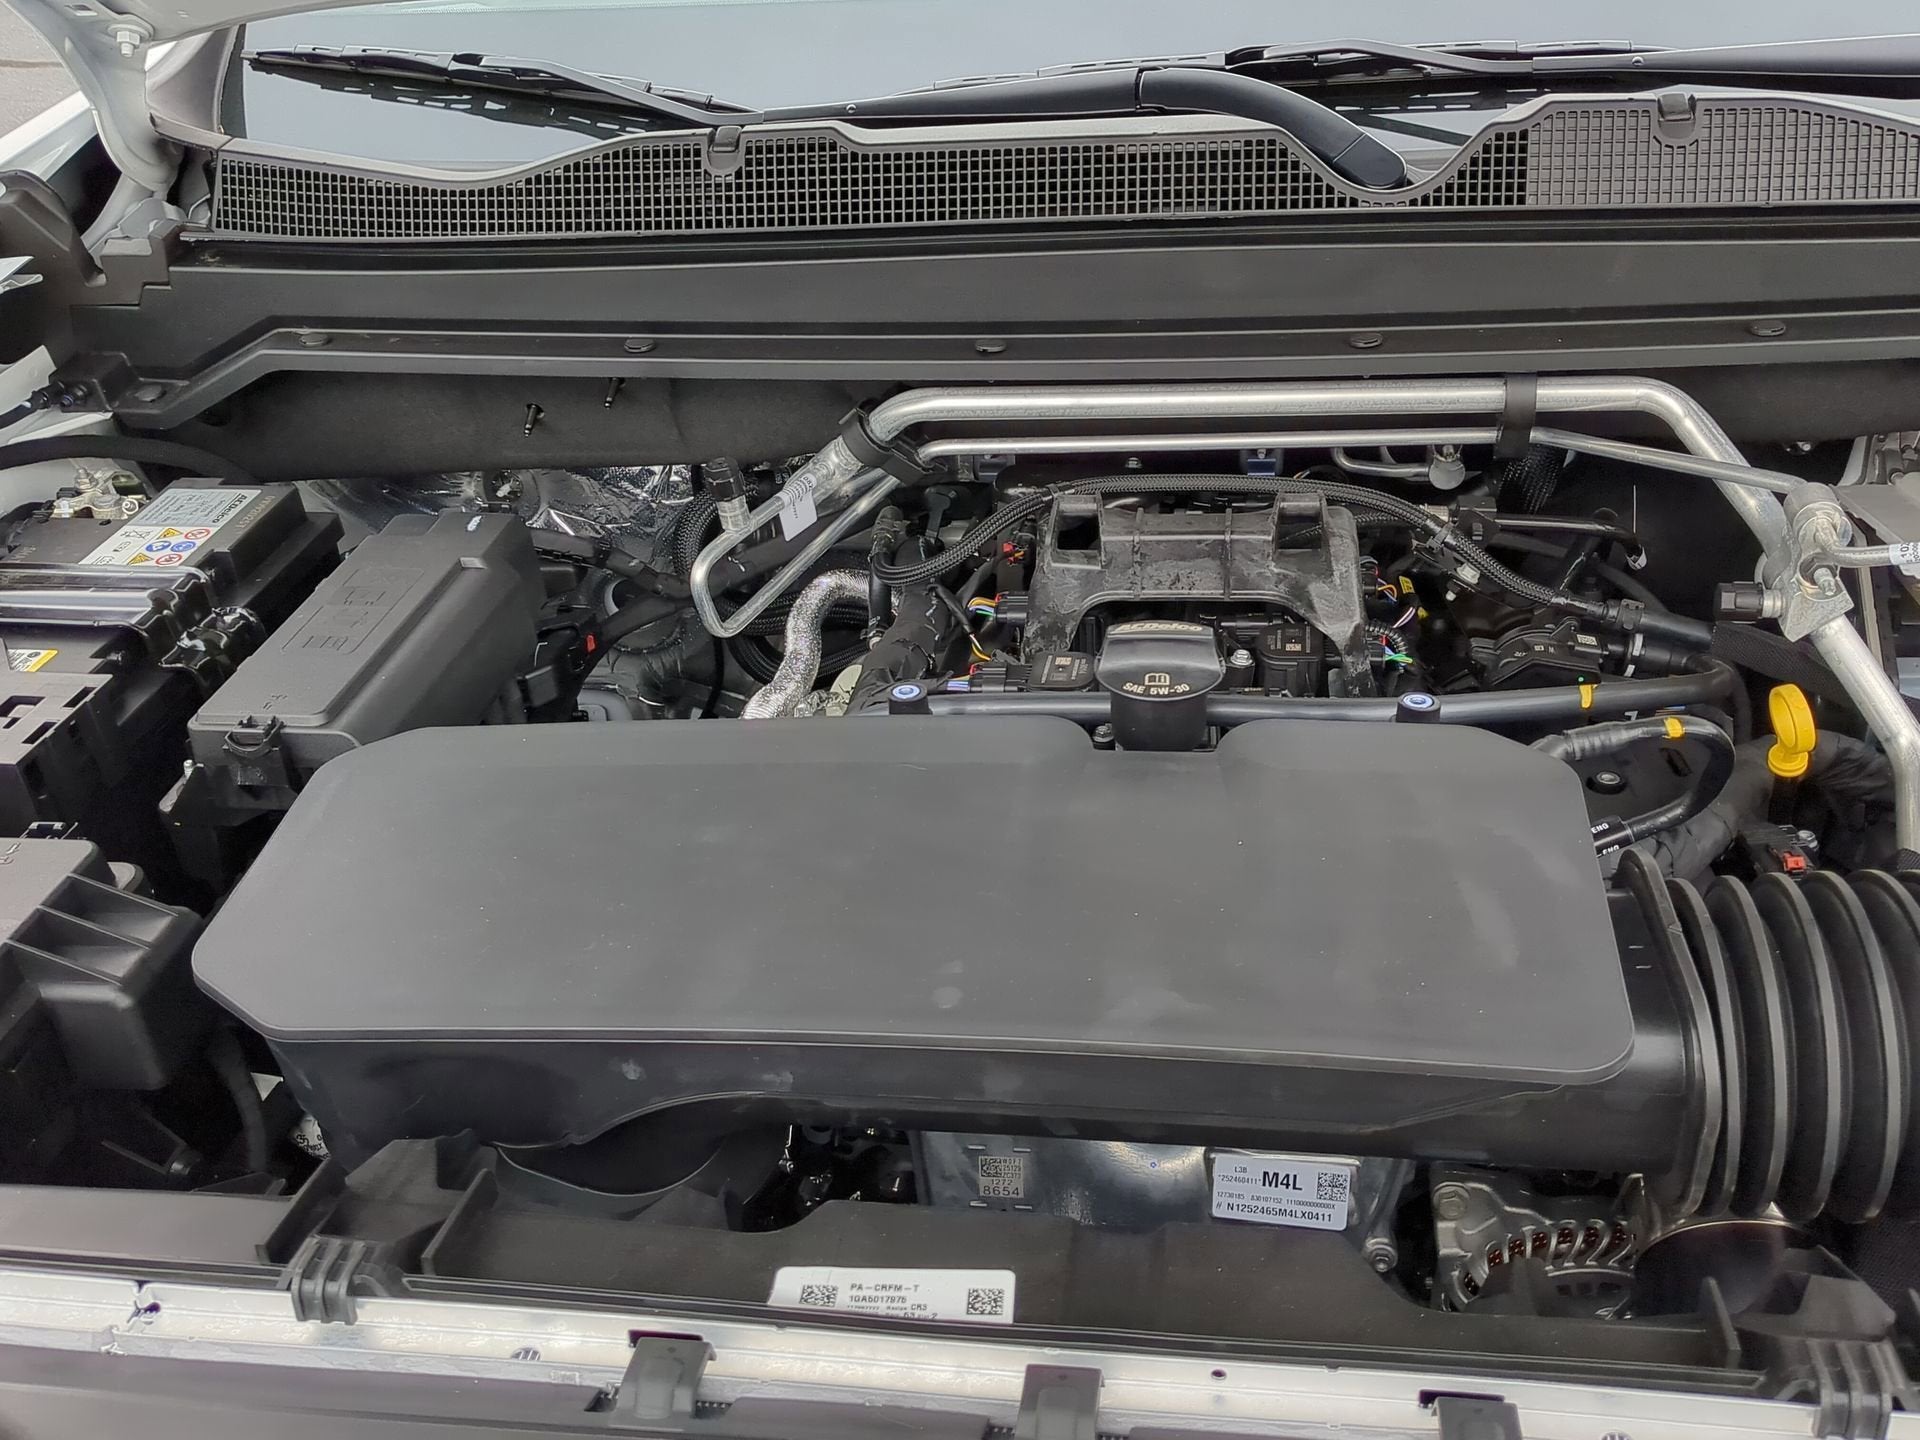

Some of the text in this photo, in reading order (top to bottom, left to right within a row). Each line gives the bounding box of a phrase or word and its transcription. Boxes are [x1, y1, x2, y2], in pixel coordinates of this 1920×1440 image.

[1113, 622, 1203, 633] ACDelco
[1122, 682, 1190, 695] SAE 5W-30
[1262, 1171, 1303, 1191] M4L
[983, 1185, 1019, 1197] 8654
[1227, 1202, 1332, 1222] N1252465M4LX0411
